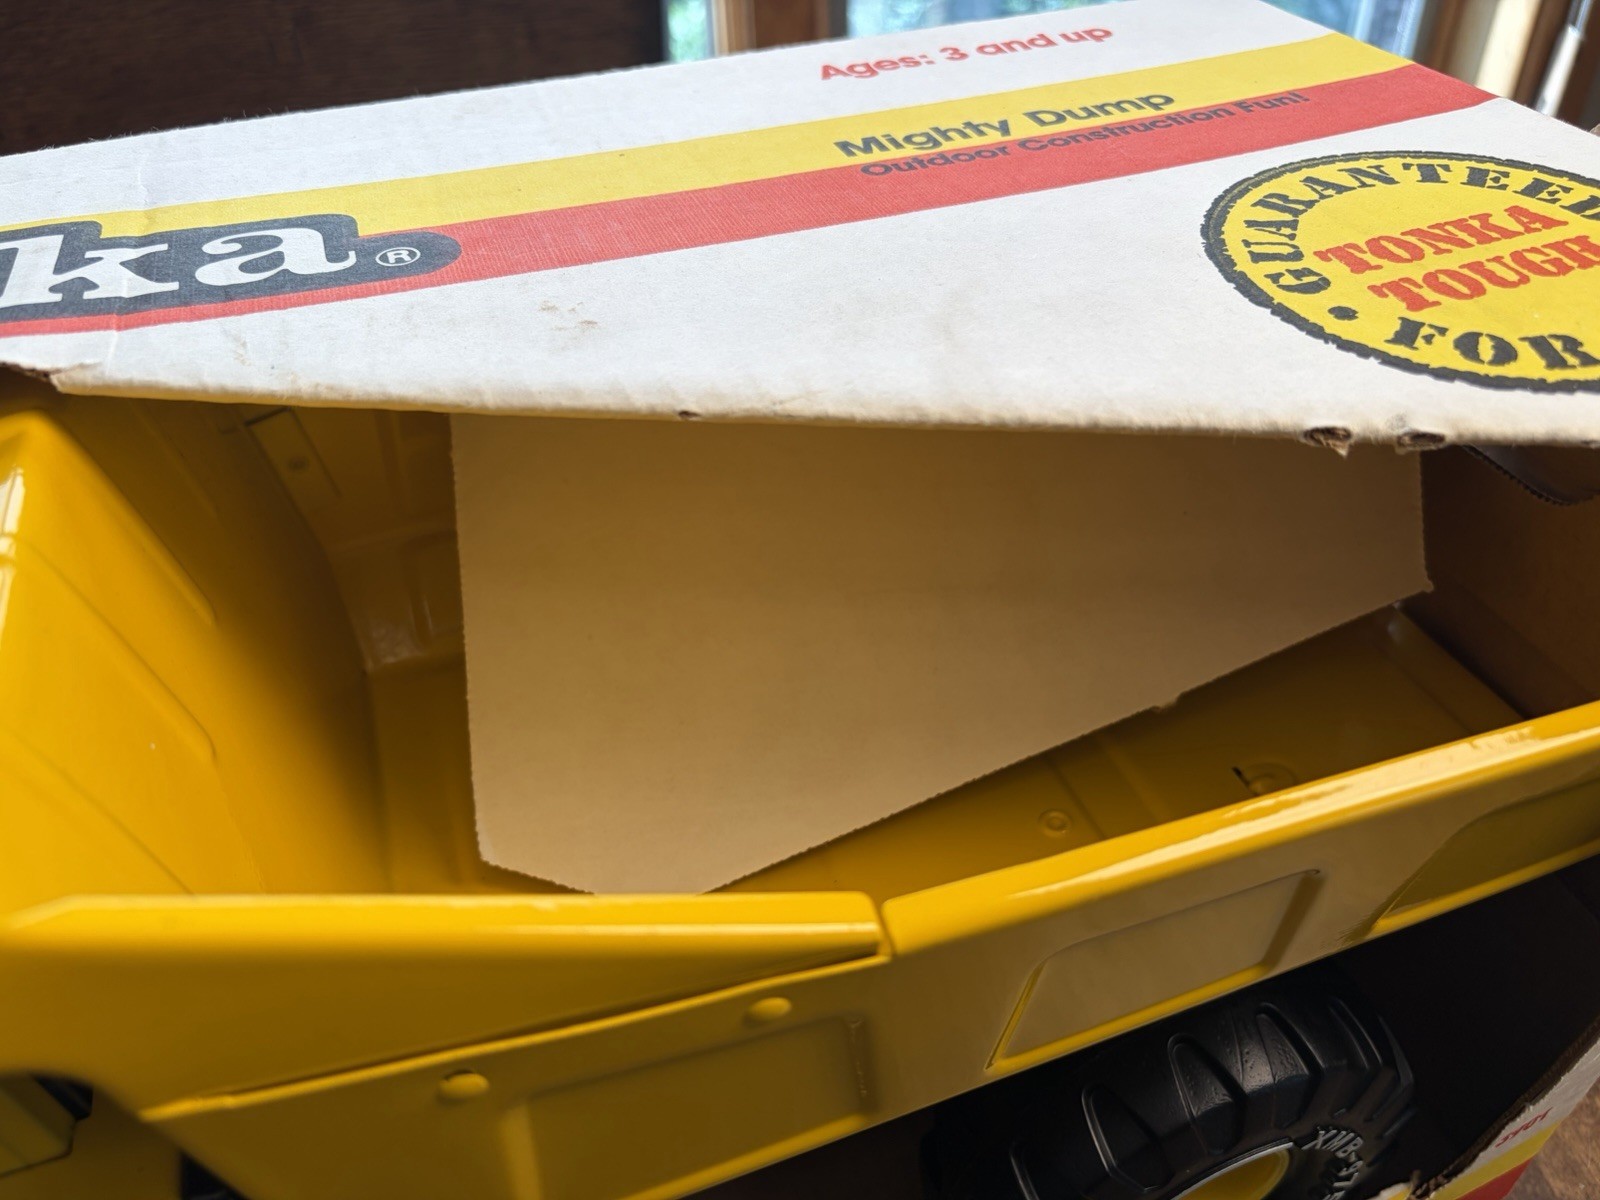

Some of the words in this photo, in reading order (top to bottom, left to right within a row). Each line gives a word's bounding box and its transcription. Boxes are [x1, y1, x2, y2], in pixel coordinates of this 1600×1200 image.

[821, 54, 935, 80] Ages:
[939, 47, 969, 61] 3
[976, 33, 1058, 56] and
[1058, 26, 1113, 43] up
[833, 119, 1011, 157] Mighty
[1022, 94, 1175, 128] Dump
[860, 144, 1011, 176] Outdoor
[1018, 104, 1235, 153] Construction
[1234, 92, 1310, 113] Fun!
[1313, 205, 1569, 275] TONKA
[1367, 235, 1600, 312] TOUGH
[1384, 317, 1600, 370] FOR
